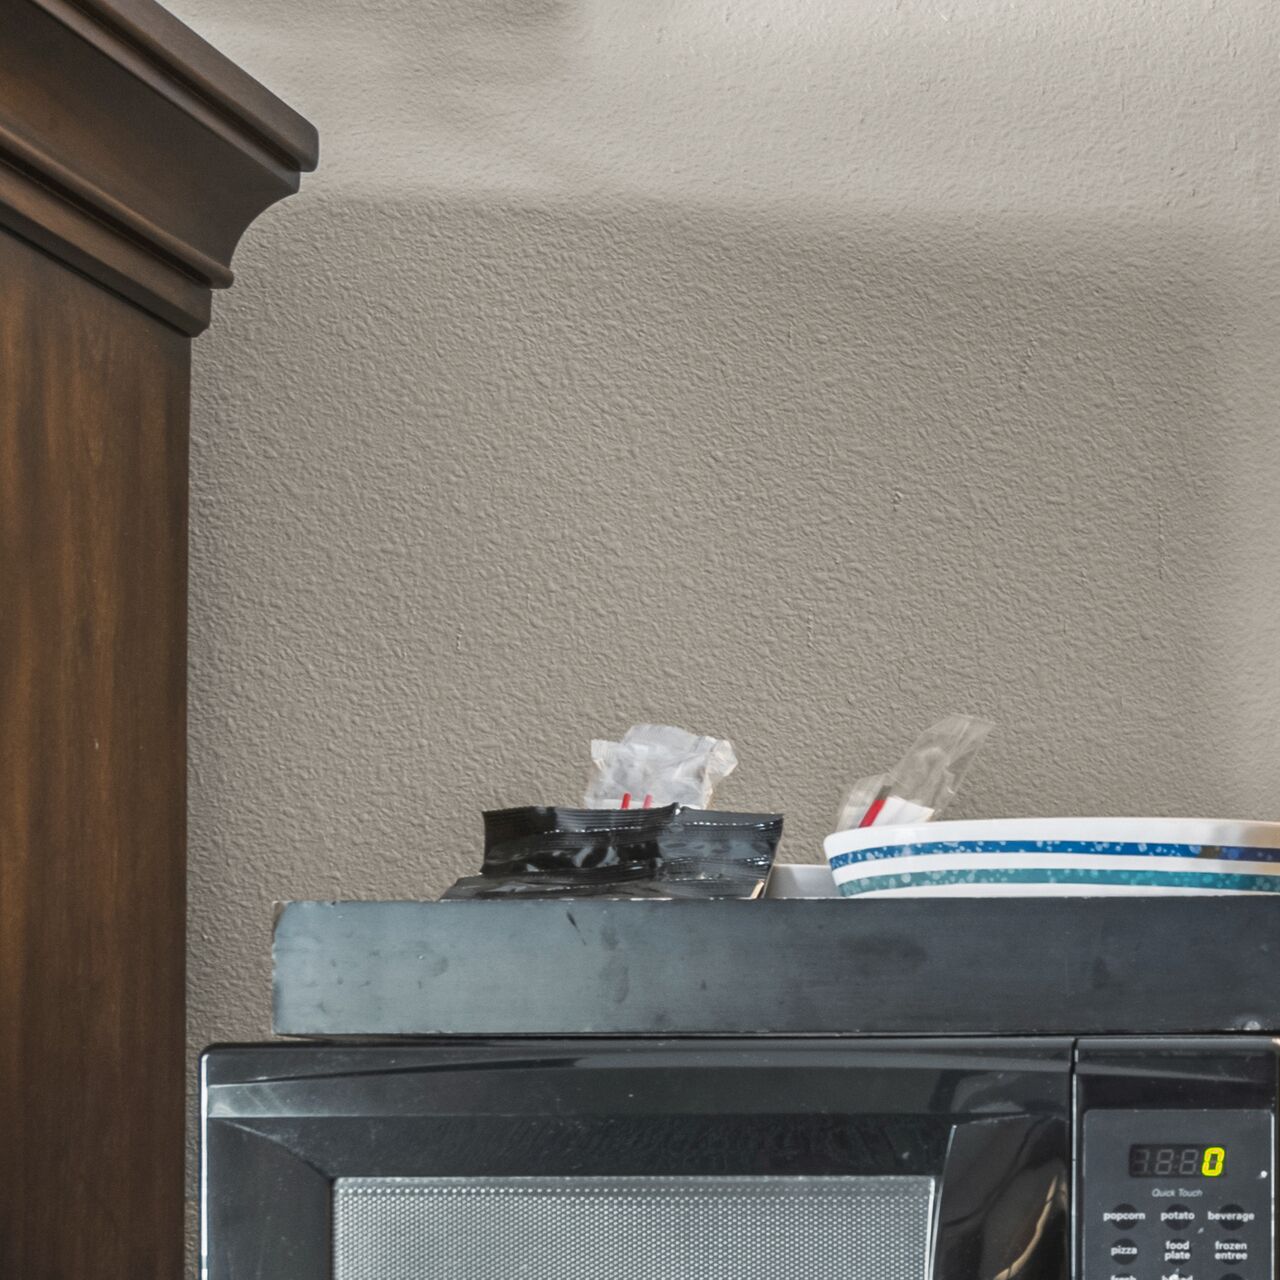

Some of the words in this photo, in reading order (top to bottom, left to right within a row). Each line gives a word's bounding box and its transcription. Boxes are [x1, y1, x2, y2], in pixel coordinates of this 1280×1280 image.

[1151, 1188, 1176, 1198] Quick
[1178, 1188, 1203, 1198] Touch
[1103, 1211, 1146, 1221] popcorn
[1160, 1211, 1195, 1221] potato
[1207, 1211, 1255, 1222] beverage
[1110, 1245, 1138, 1256] pizza
[1165, 1241, 1190, 1250] food
[1214, 1241, 1247, 1250] frozen
[1164, 1251, 1191, 1261] plate
[1214, 1251, 1248, 1260] entree
